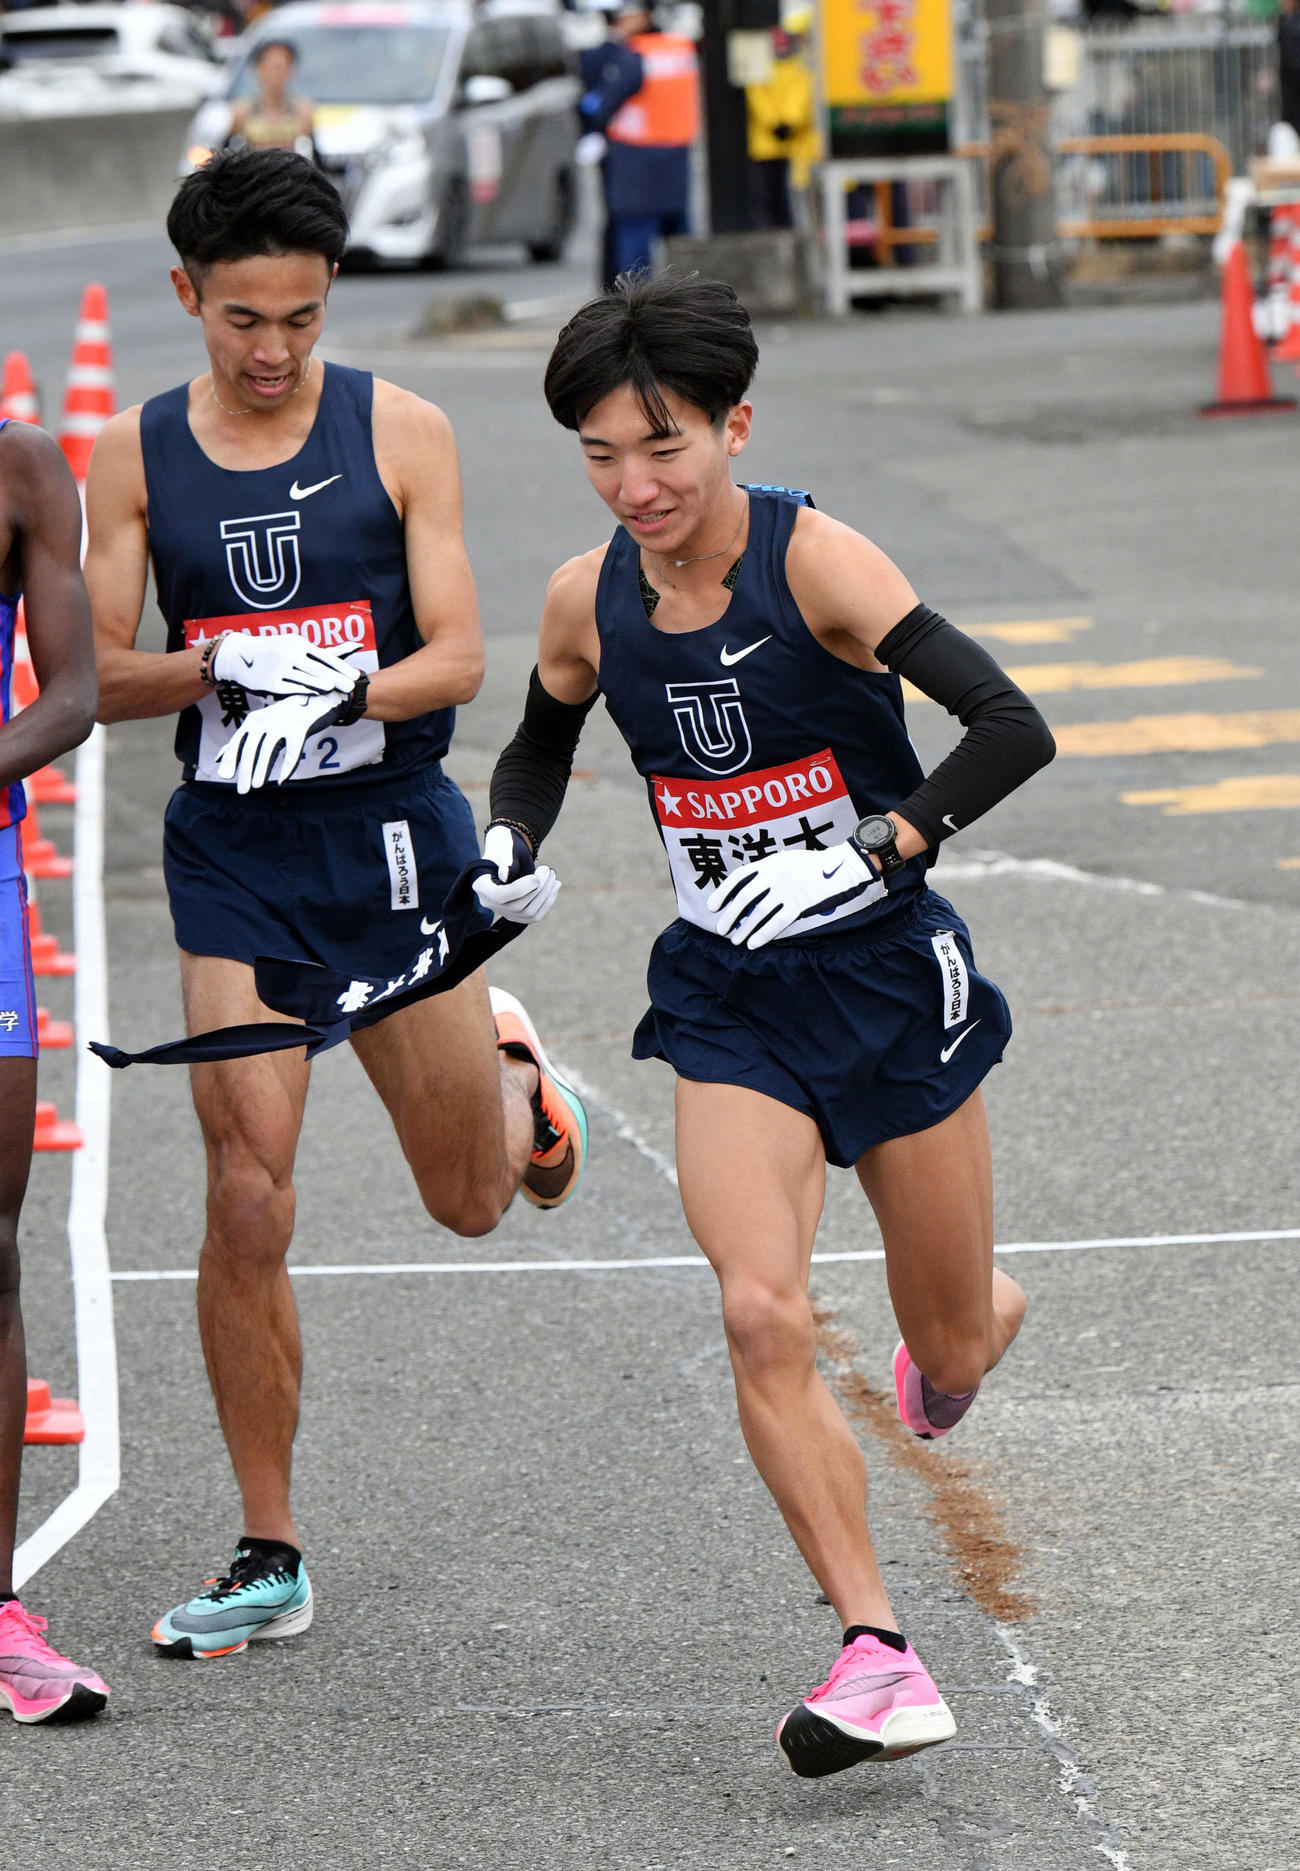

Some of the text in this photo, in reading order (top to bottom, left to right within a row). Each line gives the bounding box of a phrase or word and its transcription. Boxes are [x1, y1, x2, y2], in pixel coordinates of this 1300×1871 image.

[686, 765, 834, 820] SAPPORO
[391, 830, 412, 906] がんばろう日本
[940, 942, 962, 1021] がんばろう日本
